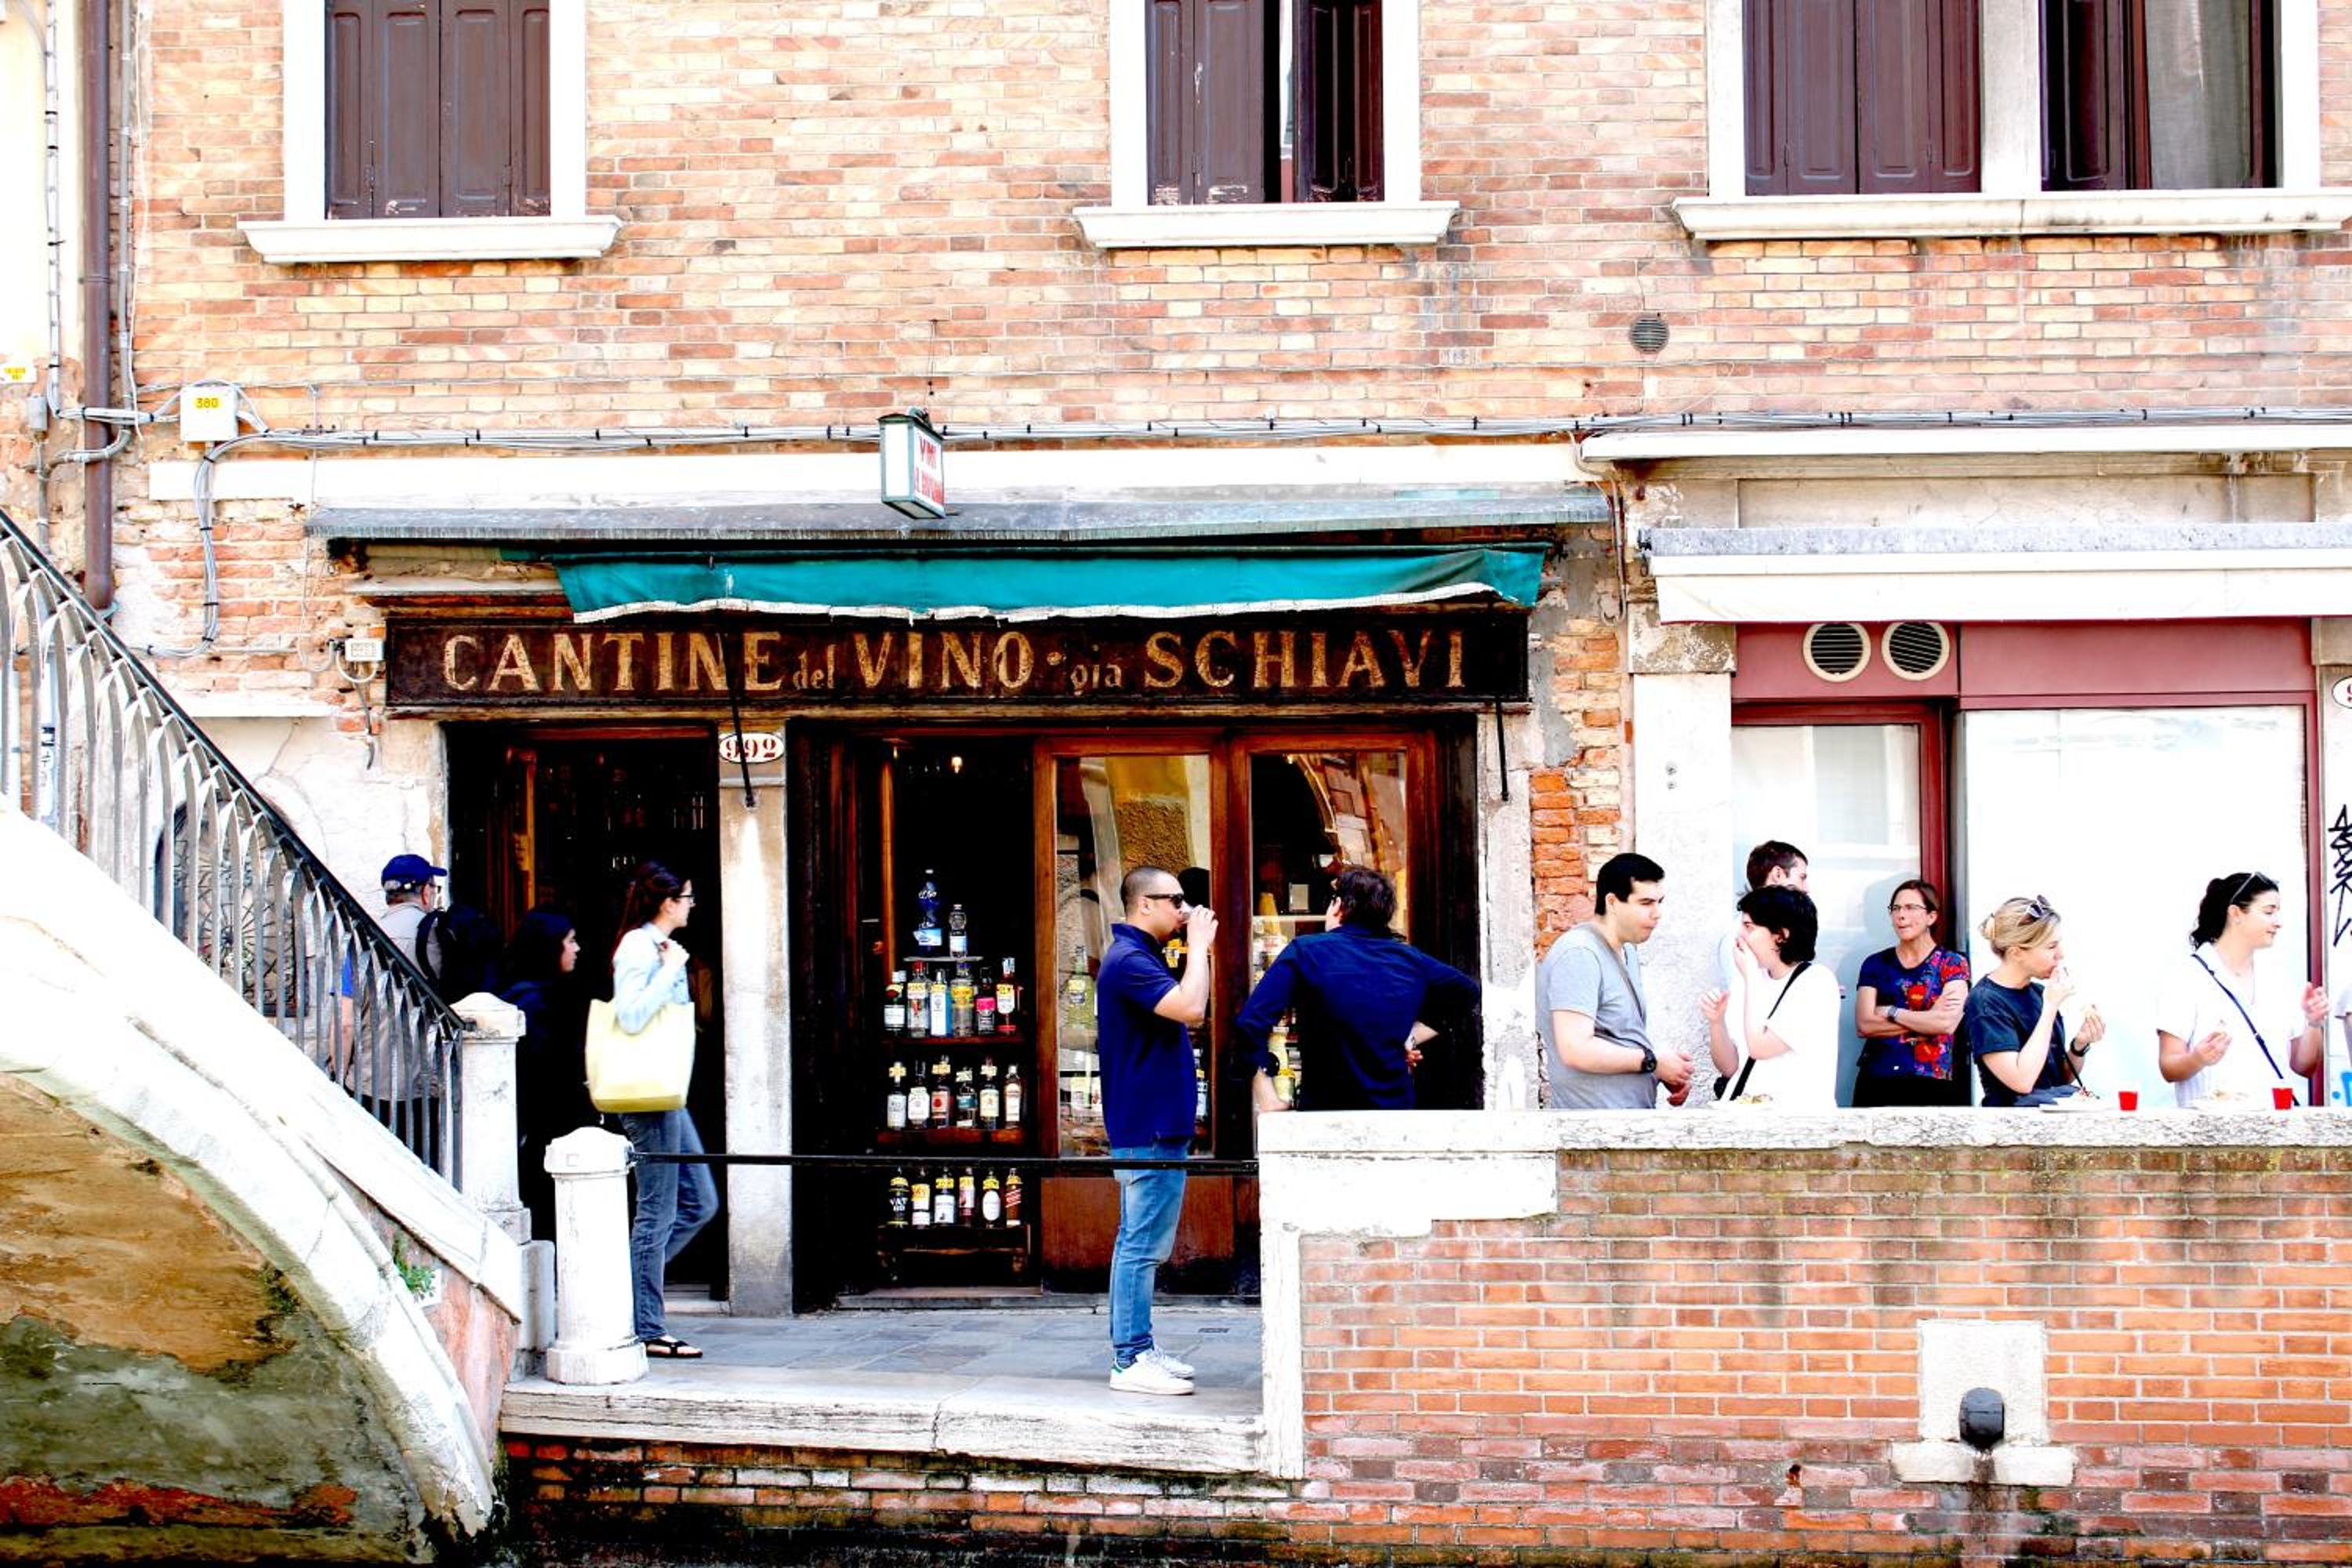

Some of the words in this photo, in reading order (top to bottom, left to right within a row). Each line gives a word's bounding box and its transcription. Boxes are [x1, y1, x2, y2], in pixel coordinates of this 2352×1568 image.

[444, 630, 783, 692] CANTINE
[792, 643, 837, 691] del
[853, 630, 1035, 690] VINO
[1144, 630, 1466, 688] SCHIAVI
[726, 739, 777, 758] 992
